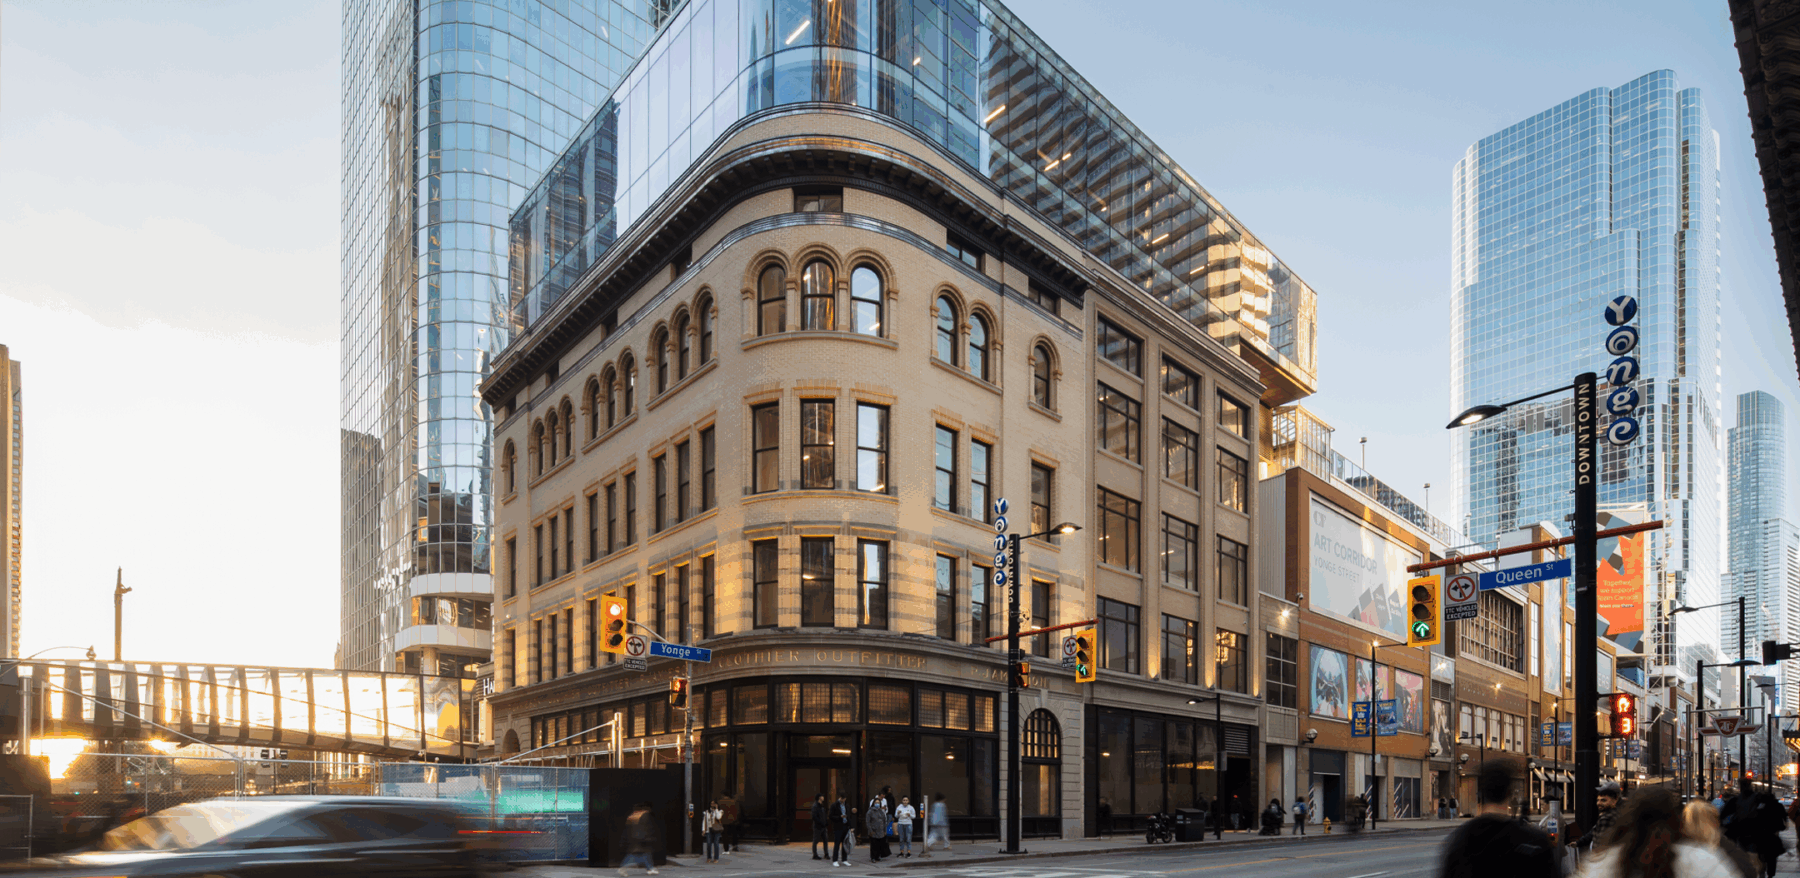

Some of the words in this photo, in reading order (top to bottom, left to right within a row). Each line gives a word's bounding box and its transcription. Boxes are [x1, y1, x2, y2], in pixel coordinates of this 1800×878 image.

[1605, 295, 1638, 445] Yonge
[1578, 382, 1591, 486] DOWNTOWN
[994, 497, 1007, 587] Yonge
[1314, 532, 1332, 554] ART
[1333, 541, 1378, 576] CORRIDOR
[1314, 554, 1336, 575] YONGE
[1337, 565, 1360, 584] STREET
[1495, 567, 1542, 584] Queen
[1545, 563, 1554, 571] St
[1446, 610, 1476, 620] EXCEPTED
[1456, 604, 1477, 613] VEHICLES
[661, 643, 691, 658] Yonge
[718, 650, 799, 668] CLOTHIER
[816, 650, 927, 669] OUTFITTER
[1621, 717, 1631, 733] 3
